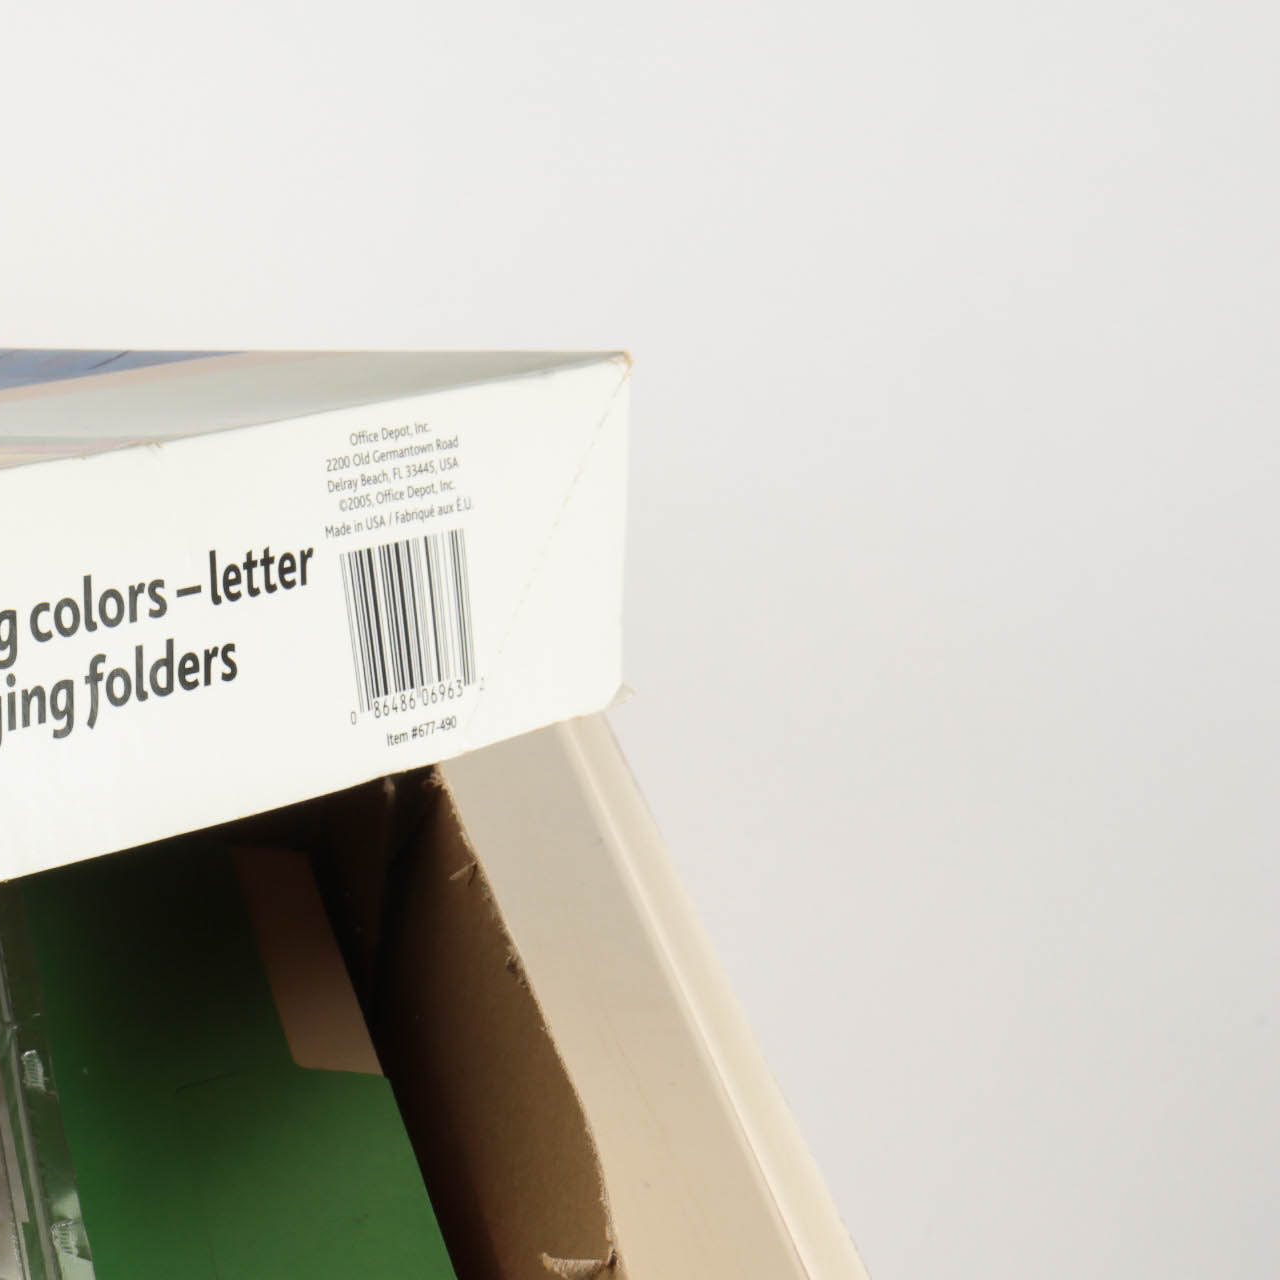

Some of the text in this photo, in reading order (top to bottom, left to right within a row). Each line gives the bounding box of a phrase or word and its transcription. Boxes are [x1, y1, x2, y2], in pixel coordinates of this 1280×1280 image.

[350, 421, 432, 446] Office Depot, Inc.
[326, 435, 459, 472] 2200 Old Germantown Road
[327, 456, 459, 493] Delray Beach, FL 33445, USA
[376, 486, 405, 504] Office
[407, 482, 438, 500] Depot,
[440, 479, 456, 491] Inc.
[325, 523, 351, 538] Made
[354, 519, 363, 532] in
[365, 514, 386, 530] USA
[395, 505, 436, 525] Fabriqué
[438, 503, 454, 515] aux
[85, 637, 239, 731] folders
[374, 692, 416, 718] 86486
[422, 680, 463, 706] 06963
[387, 715, 456, 746] Item #677-490
